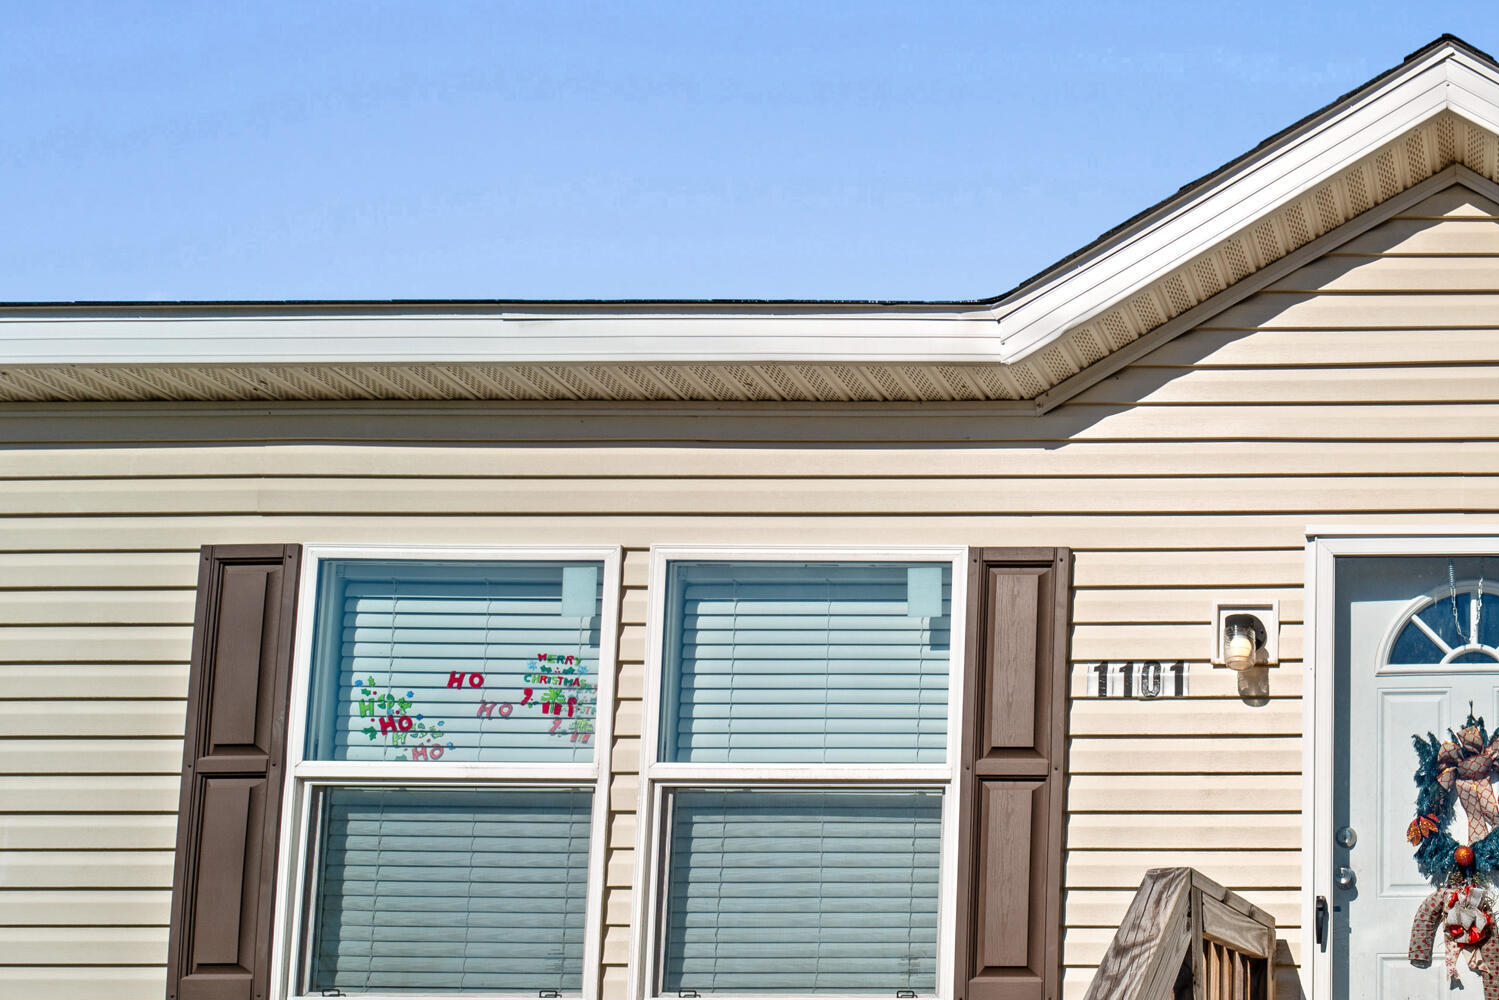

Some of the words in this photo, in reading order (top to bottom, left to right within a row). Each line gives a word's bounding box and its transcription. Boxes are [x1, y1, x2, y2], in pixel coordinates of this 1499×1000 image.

[537, 653, 582, 666] MERRY
[447, 670, 485, 690] HO
[523, 673, 587, 688] CHRISTMAS
[1093, 660, 1184, 697] 1101
[379, 714, 413, 735] HO
